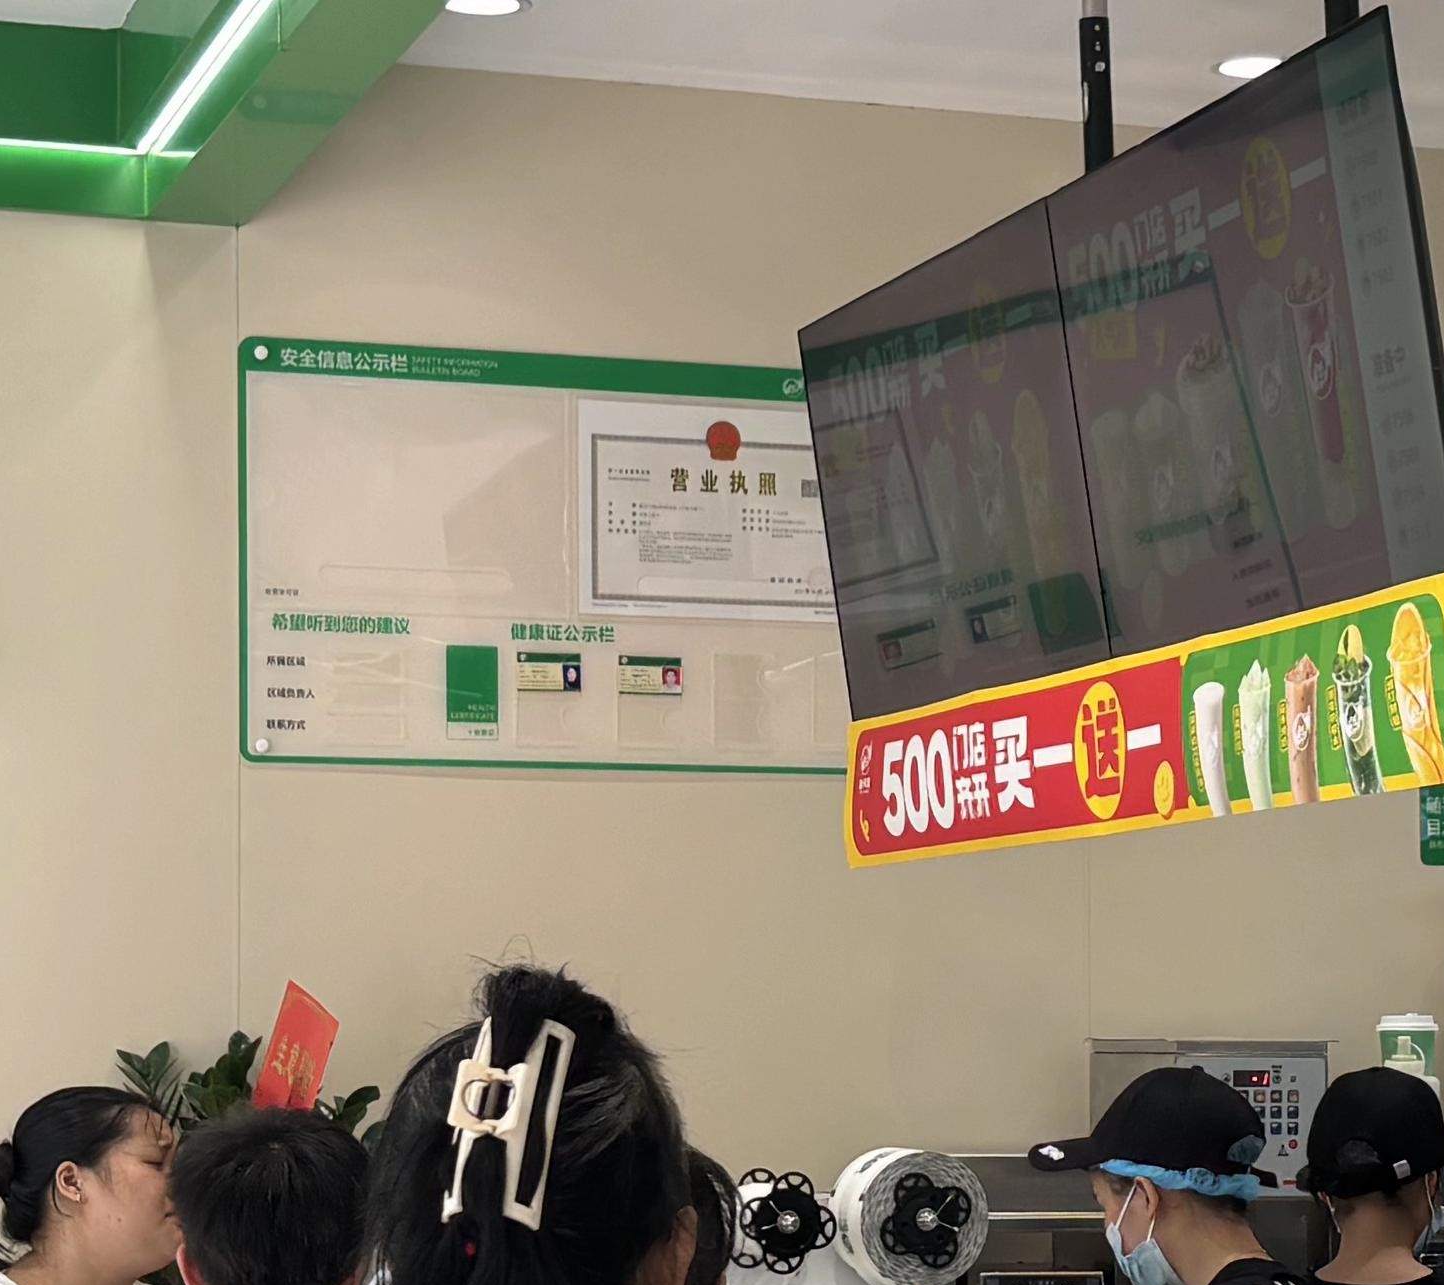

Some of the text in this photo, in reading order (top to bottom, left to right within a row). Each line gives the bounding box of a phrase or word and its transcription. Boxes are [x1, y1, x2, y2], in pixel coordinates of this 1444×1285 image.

[279, 347, 409, 372] 安全信息公示栏
[670, 468, 778, 497] 营业执照
[271, 613, 411, 635] 希望听到您的建议
[511, 623, 616, 643] 健康证公示栏
[266, 655, 306, 667] 所属区域
[266, 687, 316, 700] 区域负责人
[266, 719, 307, 731] 联系方式
[882, 728, 955, 837] 500
